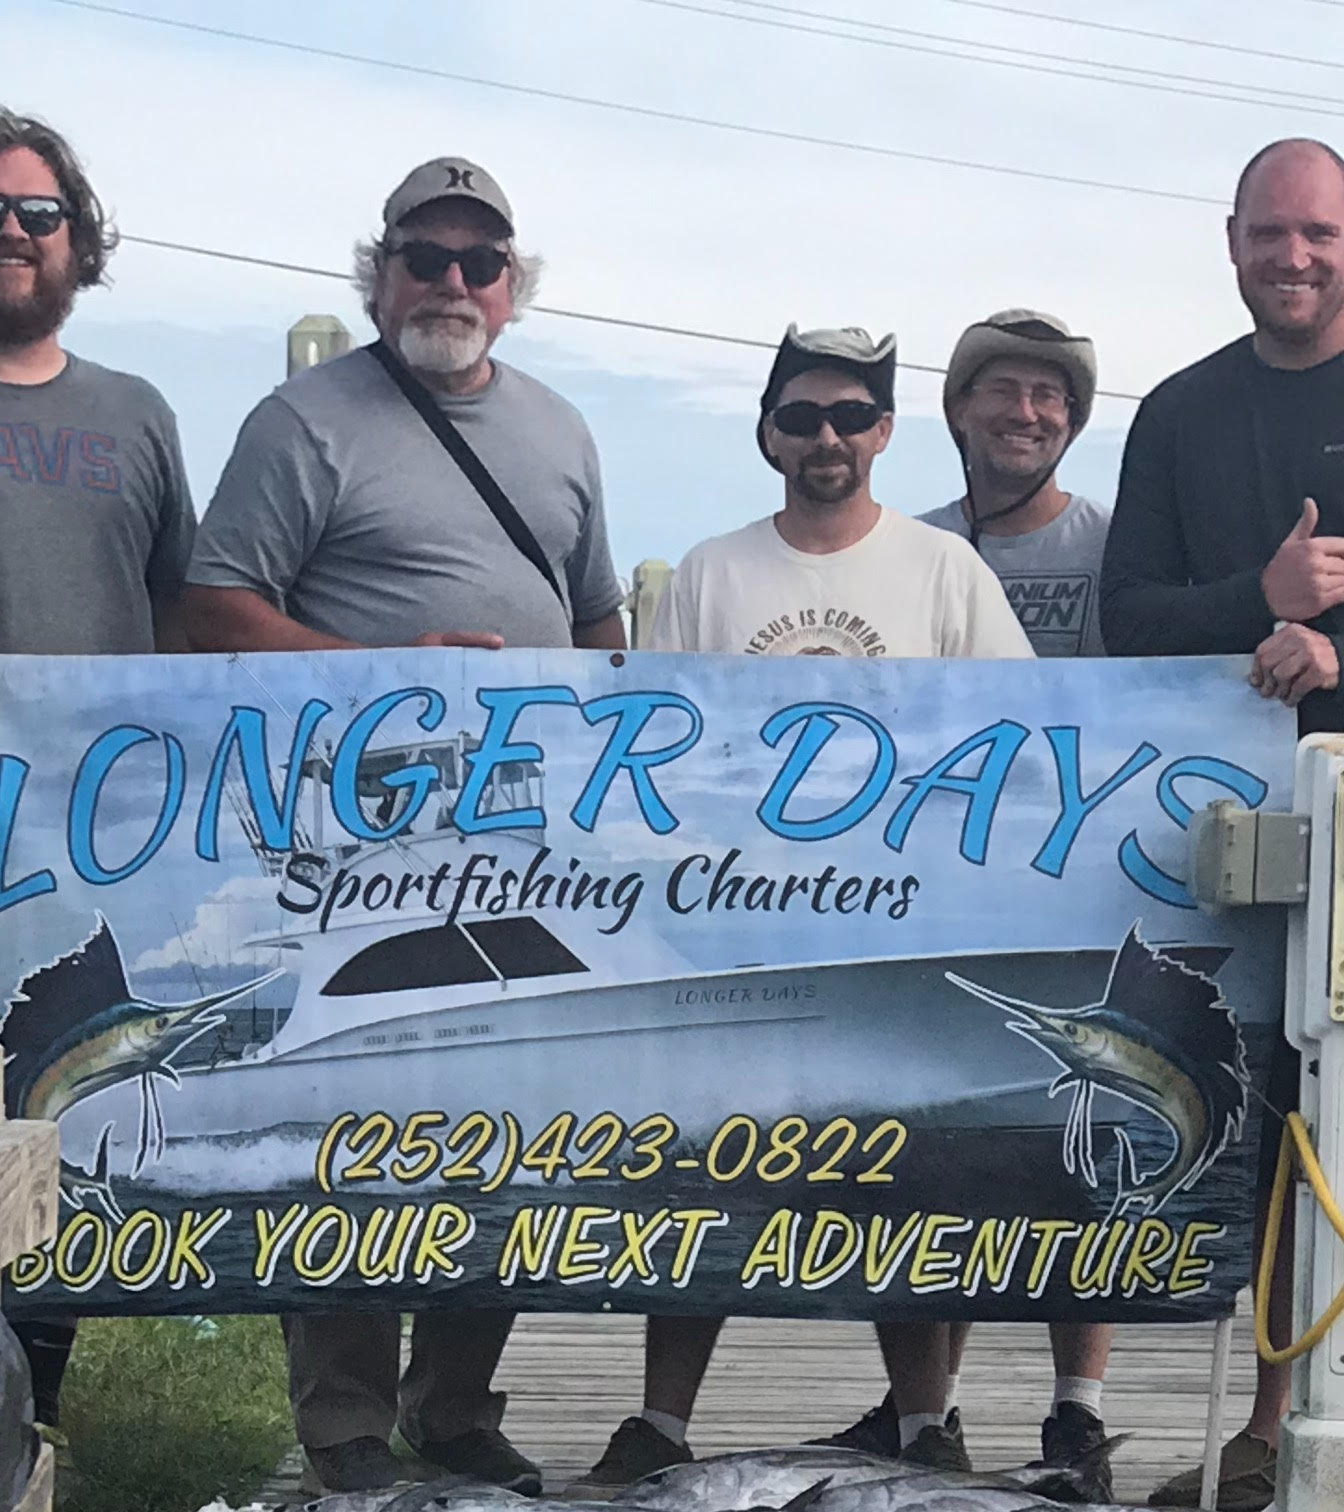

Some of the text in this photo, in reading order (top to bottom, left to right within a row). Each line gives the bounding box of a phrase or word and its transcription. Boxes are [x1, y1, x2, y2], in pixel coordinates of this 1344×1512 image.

[744, 607, 886, 657] JESUS IS COMING
[1010, 601, 1077, 627] ON
[756, 701, 1269, 909] DAYS
[276, 846, 920, 935] Sportfishing Charters
[674, 983, 817, 1005] LONGER DAYS
[315, 1111, 910, 1194] (252)423-0822
[9, 1202, 1229, 1300] BOOK YOUR NEXT ADVENTURE
